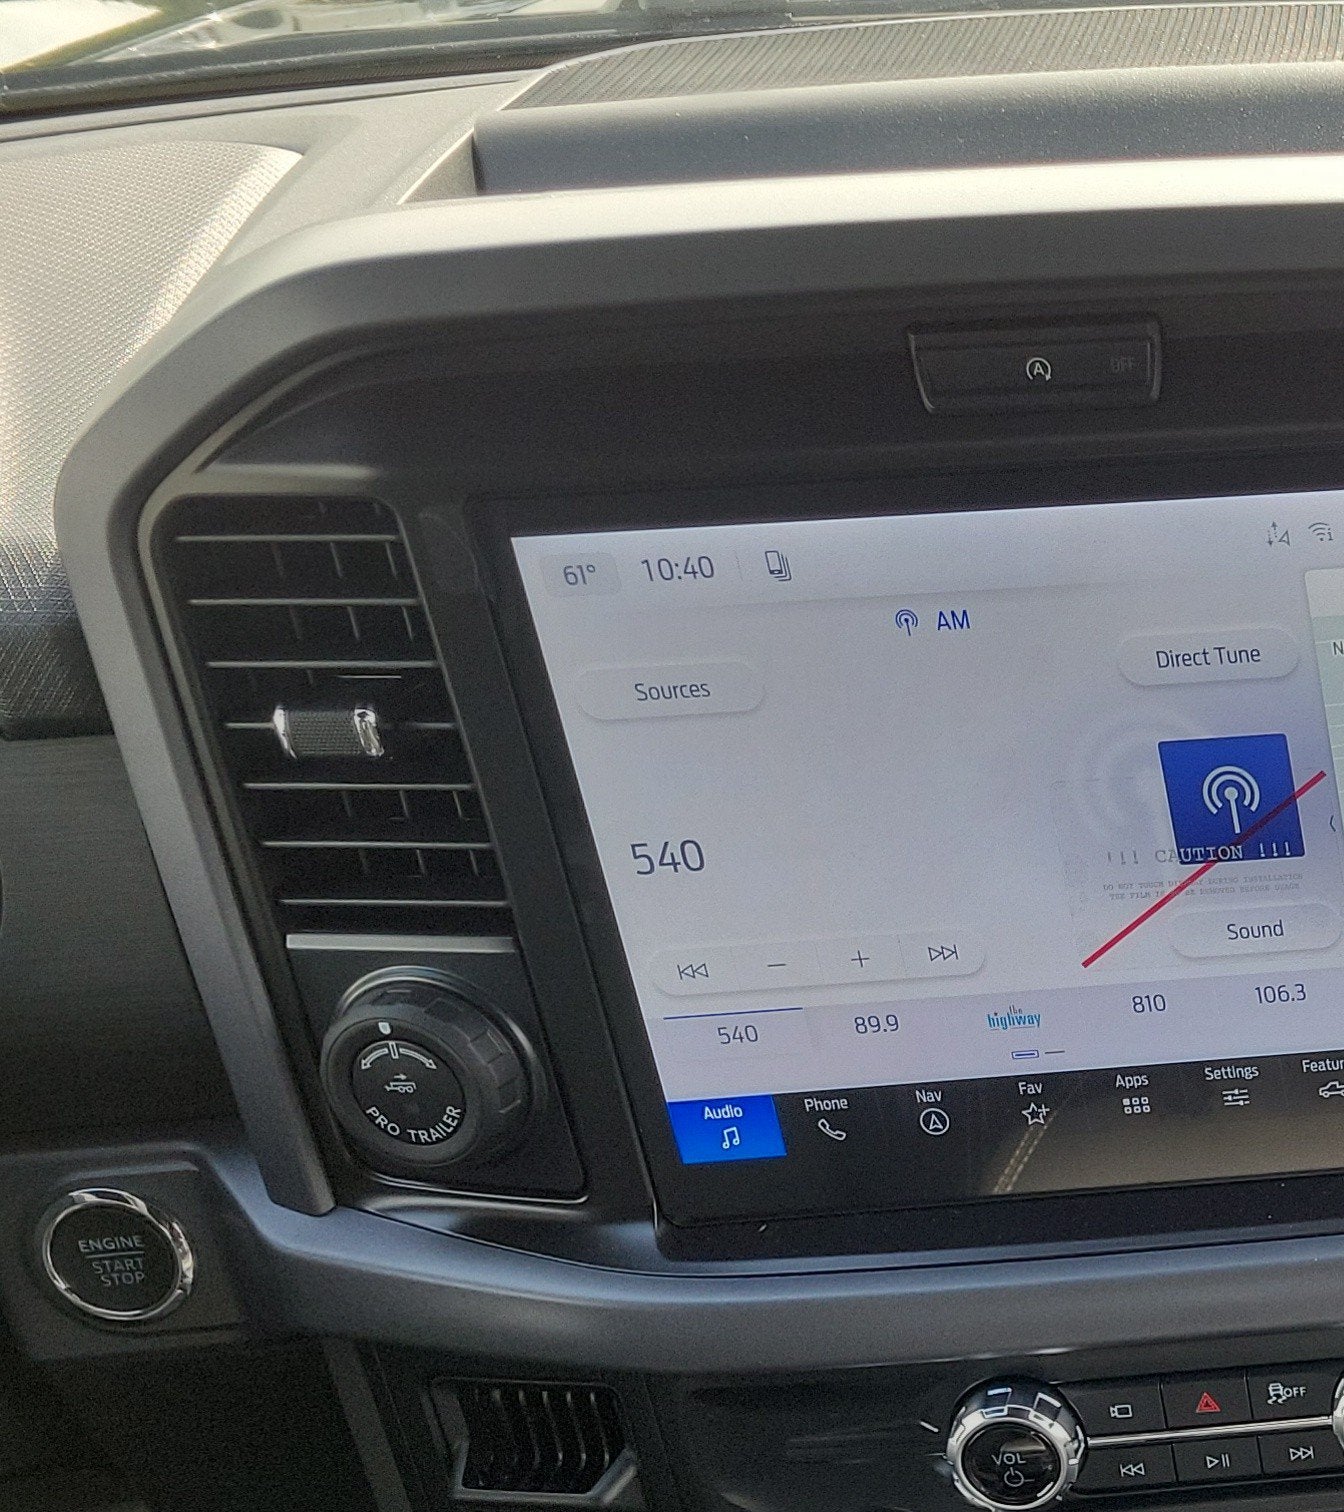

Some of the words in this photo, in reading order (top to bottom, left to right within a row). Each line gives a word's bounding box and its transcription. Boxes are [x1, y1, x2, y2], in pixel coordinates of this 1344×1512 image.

[563, 563, 597, 587] 61°
[640, 555, 715, 583] 10:40
[936, 609, 971, 632] AM
[1156, 647, 1211, 670] Direct
[1212, 644, 1261, 667] Tune
[634, 679, 711, 702] Sources
[631, 839, 706, 877] 540
[1155, 845, 1243, 863] CAUTION
[1226, 919, 1284, 941] Sound
[1132, 993, 1167, 1014] 810
[1254, 983, 1307, 1005] 106.3
[854, 1013, 900, 1035] 89.9
[987, 1011, 1041, 1031] highway
[716, 1024, 758, 1046] 540
[1115, 1072, 1149, 1090] Apps
[1205, 1063, 1259, 1082] Settings
[915, 1088, 942, 1104] Nav
[1018, 1080, 1043, 1096] Fav
[703, 1104, 743, 1121] Audio
[804, 1096, 848, 1113] Phone
[366, 1106, 400, 1136] PRO
[407, 1105, 462, 1143] TRAILER
[77, 1234, 145, 1252] ENGINE
[92, 1258, 144, 1274] START
[100, 1272, 145, 1287] STOP
[1283, 1386, 1307, 1398] OFF
[991, 1452, 1027, 1466] VOL
